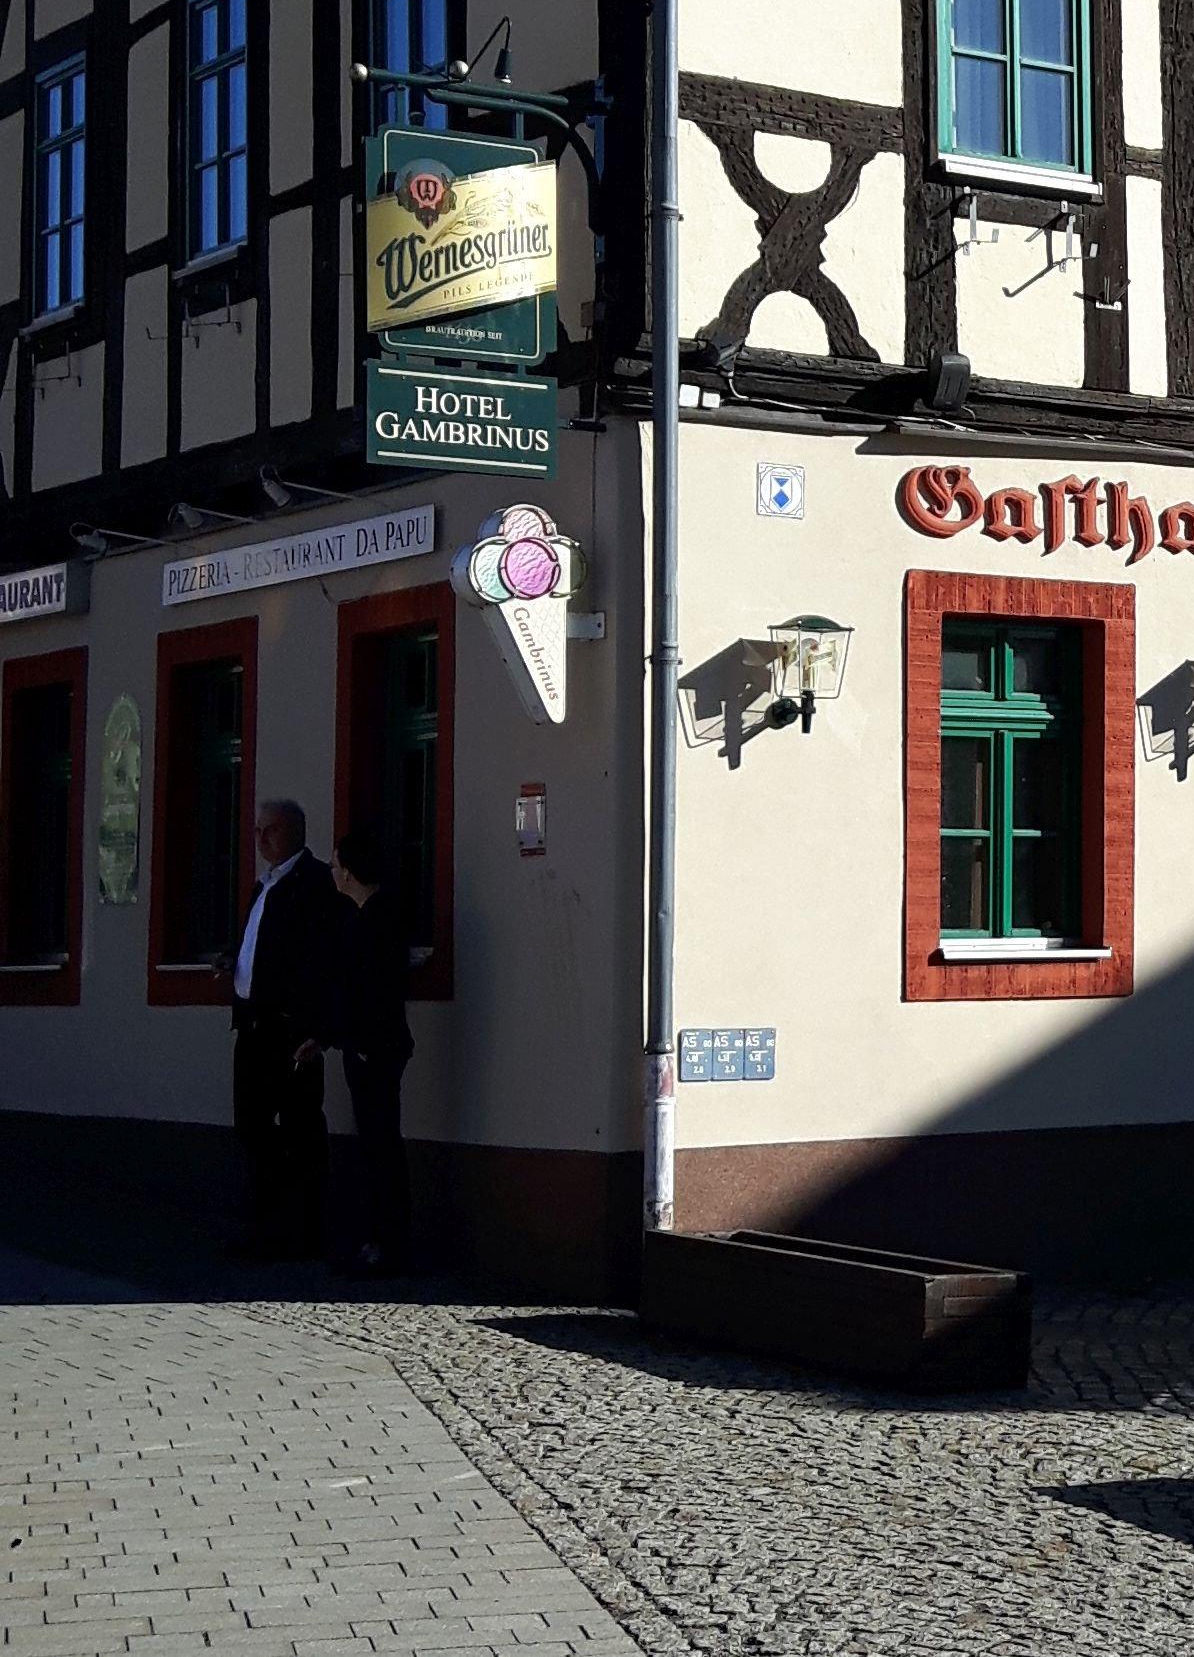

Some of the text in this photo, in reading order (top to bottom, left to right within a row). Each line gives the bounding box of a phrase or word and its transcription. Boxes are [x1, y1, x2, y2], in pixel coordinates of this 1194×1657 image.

[376, 220, 550, 301] Wernesgrüner
[443, 284, 472, 299] PILS
[414, 386, 511, 420] HOTEL
[375, 412, 549, 452] GAMBRINUS
[168, 561, 231, 596] PIZZERIA
[243, 534, 346, 581] RESTAURANT
[356, 528, 380, 558] DA
[385, 515, 428, 552] PAPU
[513, 607, 560, 701] Gambrinus
[683, 1036, 697, 1048] AS
[714, 1035, 728, 1047] AS
[746, 1035, 759, 1047] AS
